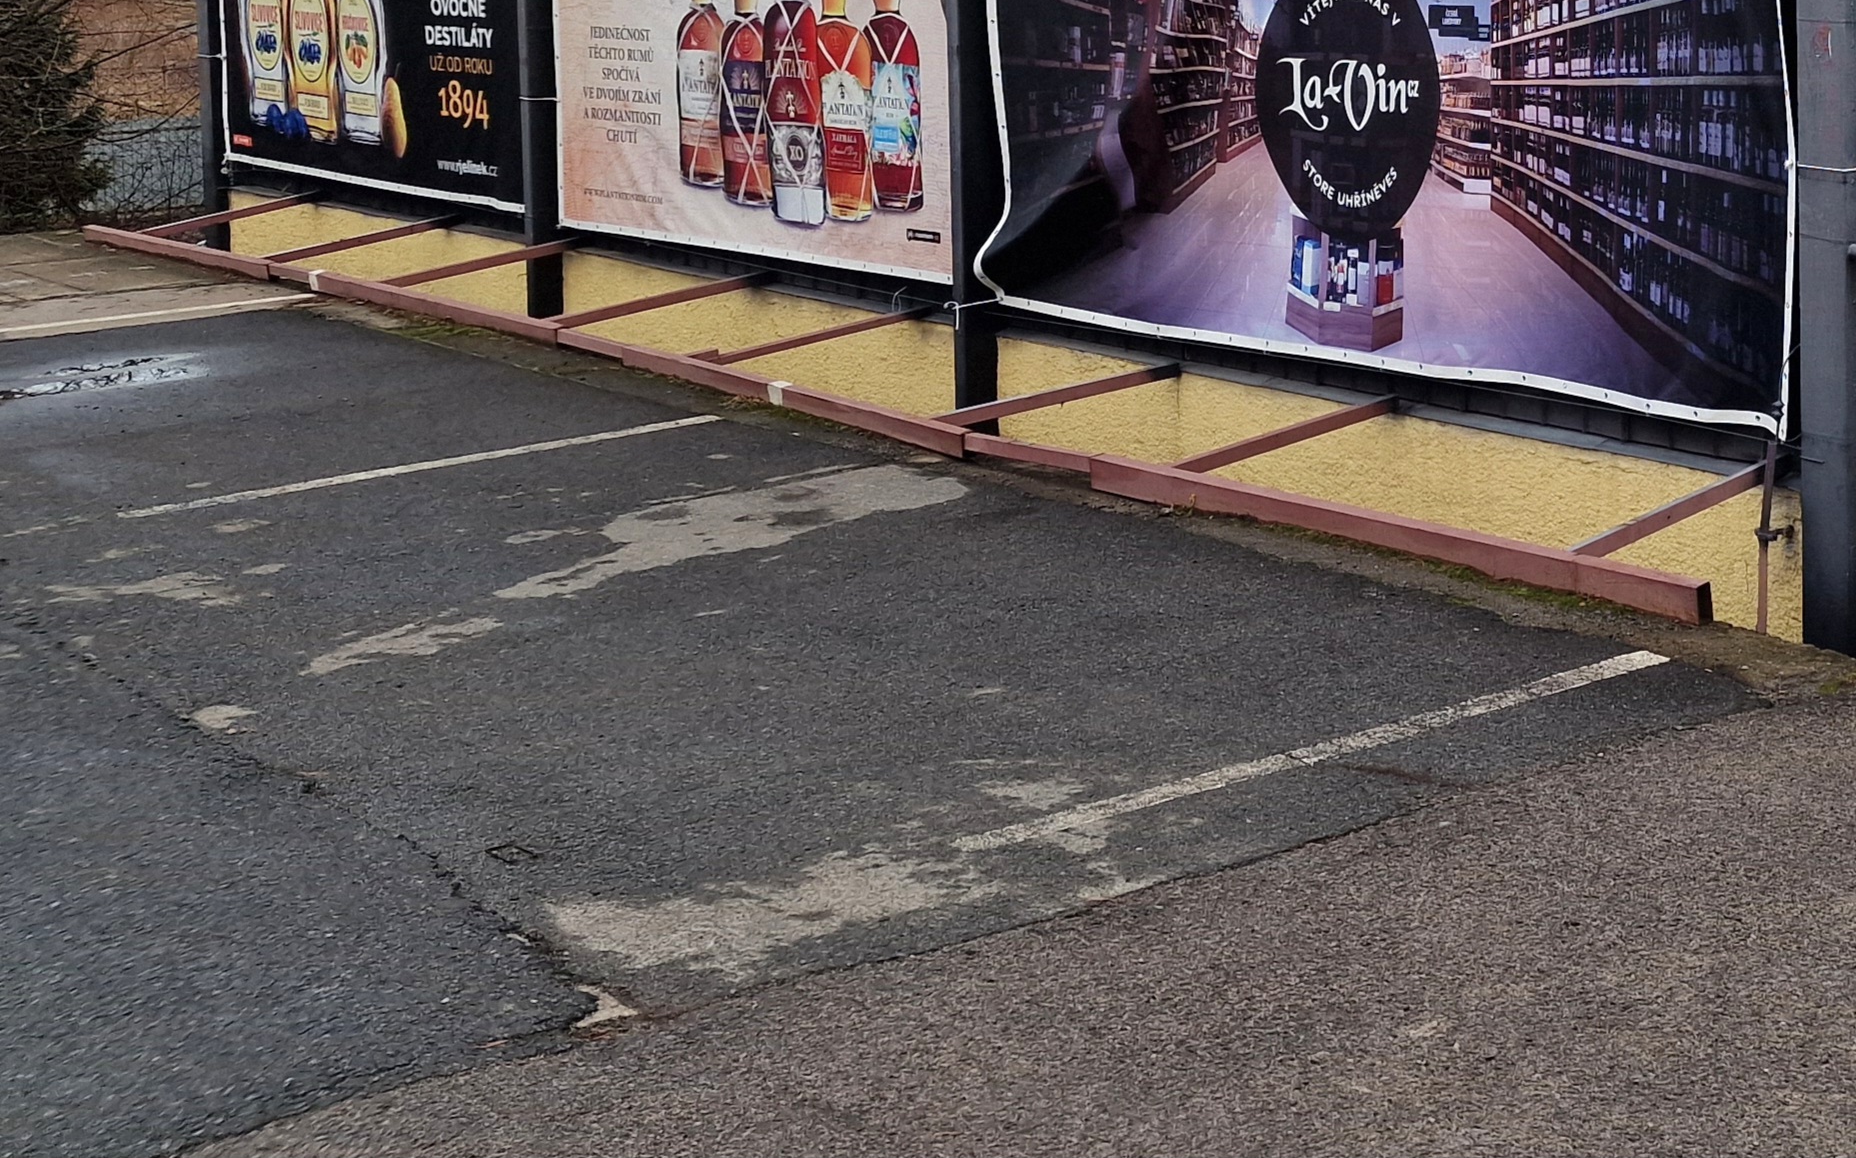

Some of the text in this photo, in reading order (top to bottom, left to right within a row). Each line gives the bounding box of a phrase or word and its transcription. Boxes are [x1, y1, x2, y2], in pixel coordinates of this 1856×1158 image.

[1391, 11, 1401, 26] V
[425, 22, 493, 48] DESTILÁTY
[590, 25, 651, 42] JEDINEČNOST
[588, 45, 654, 63] TĚCHTO RUMŮ
[429, 53, 493, 75] UŽ OD ROKU
[602, 66, 641, 83] SPOČÍVÁ
[438, 80, 490, 130] 1894
[583, 86, 662, 106] VE DVOJÍM ZRÁNÍ
[583, 107, 662, 126] A ROZMANITOSTI
[606, 128, 638, 144] CHUTÍ
[788, 145, 804, 161] XO
[1302, 159, 1398, 209] STORE UHŘÍNĚVES
